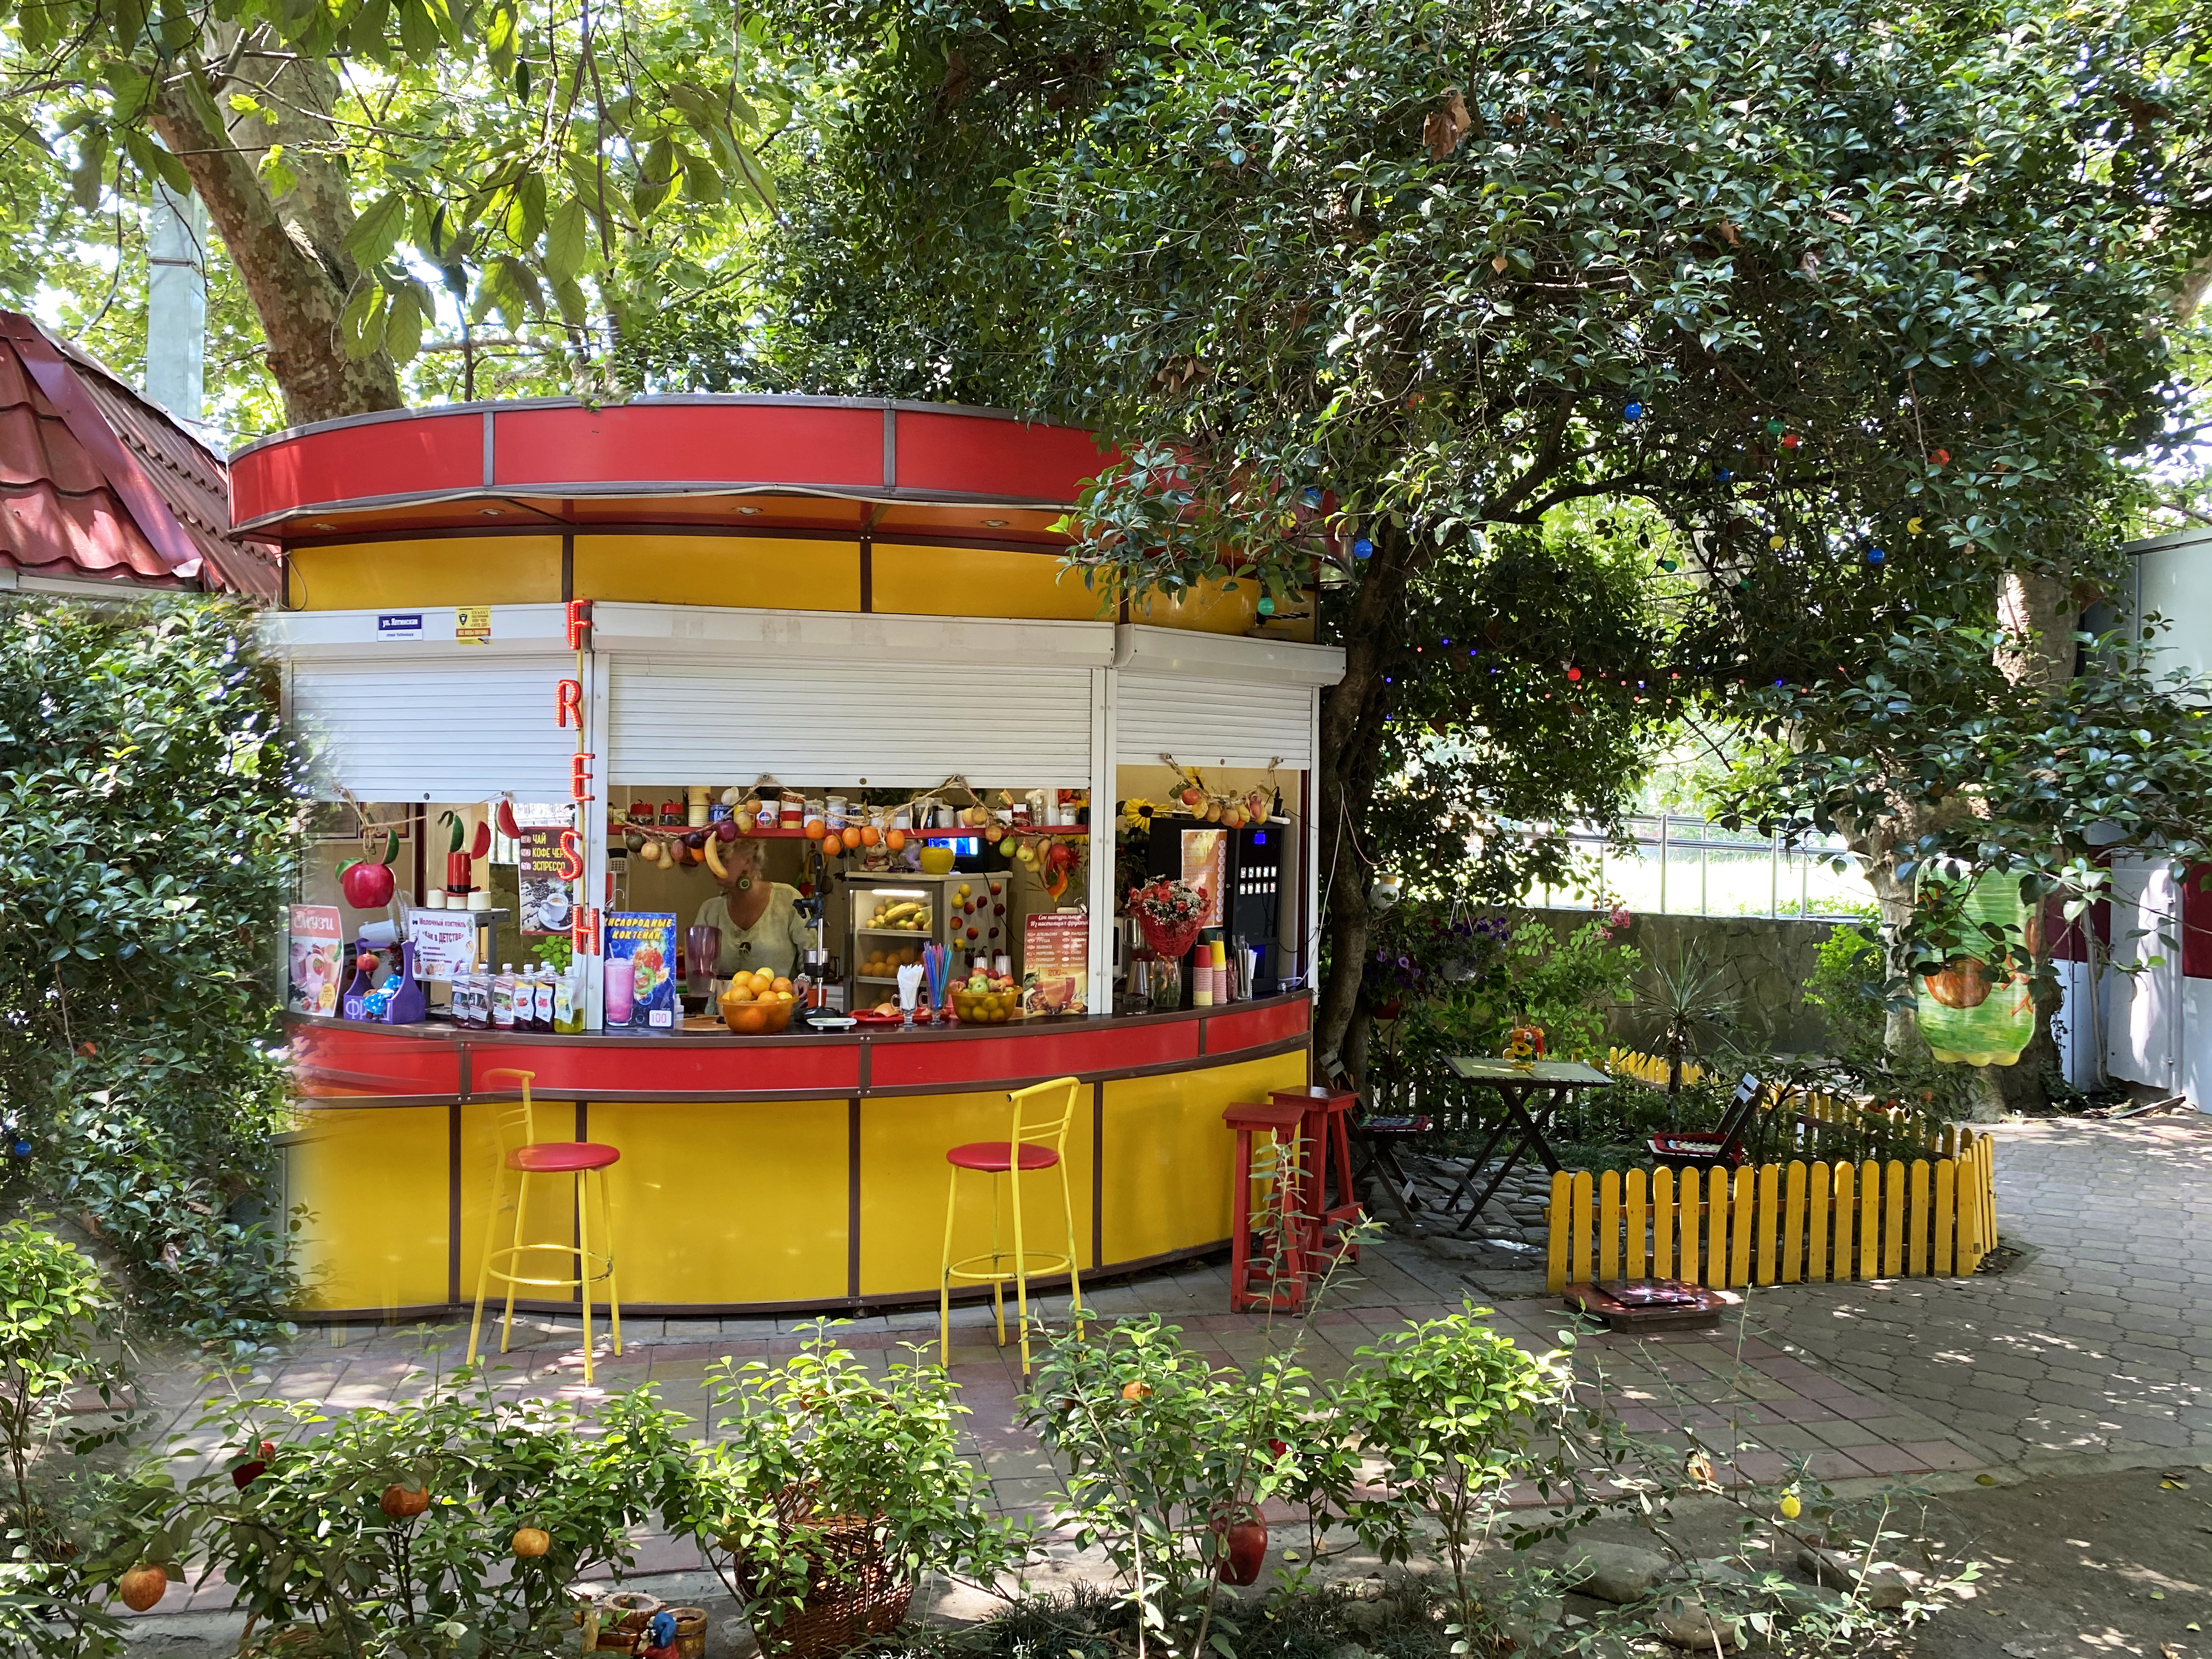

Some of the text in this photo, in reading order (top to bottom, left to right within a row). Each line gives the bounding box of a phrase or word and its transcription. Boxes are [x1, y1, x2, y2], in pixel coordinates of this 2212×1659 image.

[391, 618, 418, 626] Ялтинская
[555, 599, 601, 956] FRESH
[532, 832, 546, 844] ЧАЙ
[532, 847, 551, 858] КОФЕ
[532, 861, 566, 871] ЭСПРЕССО
[294, 915, 334, 931] СМУЗИ
[612, 929, 662, 940] КОКТЕЙЛИ
[652, 1013, 667, 1024] 100
